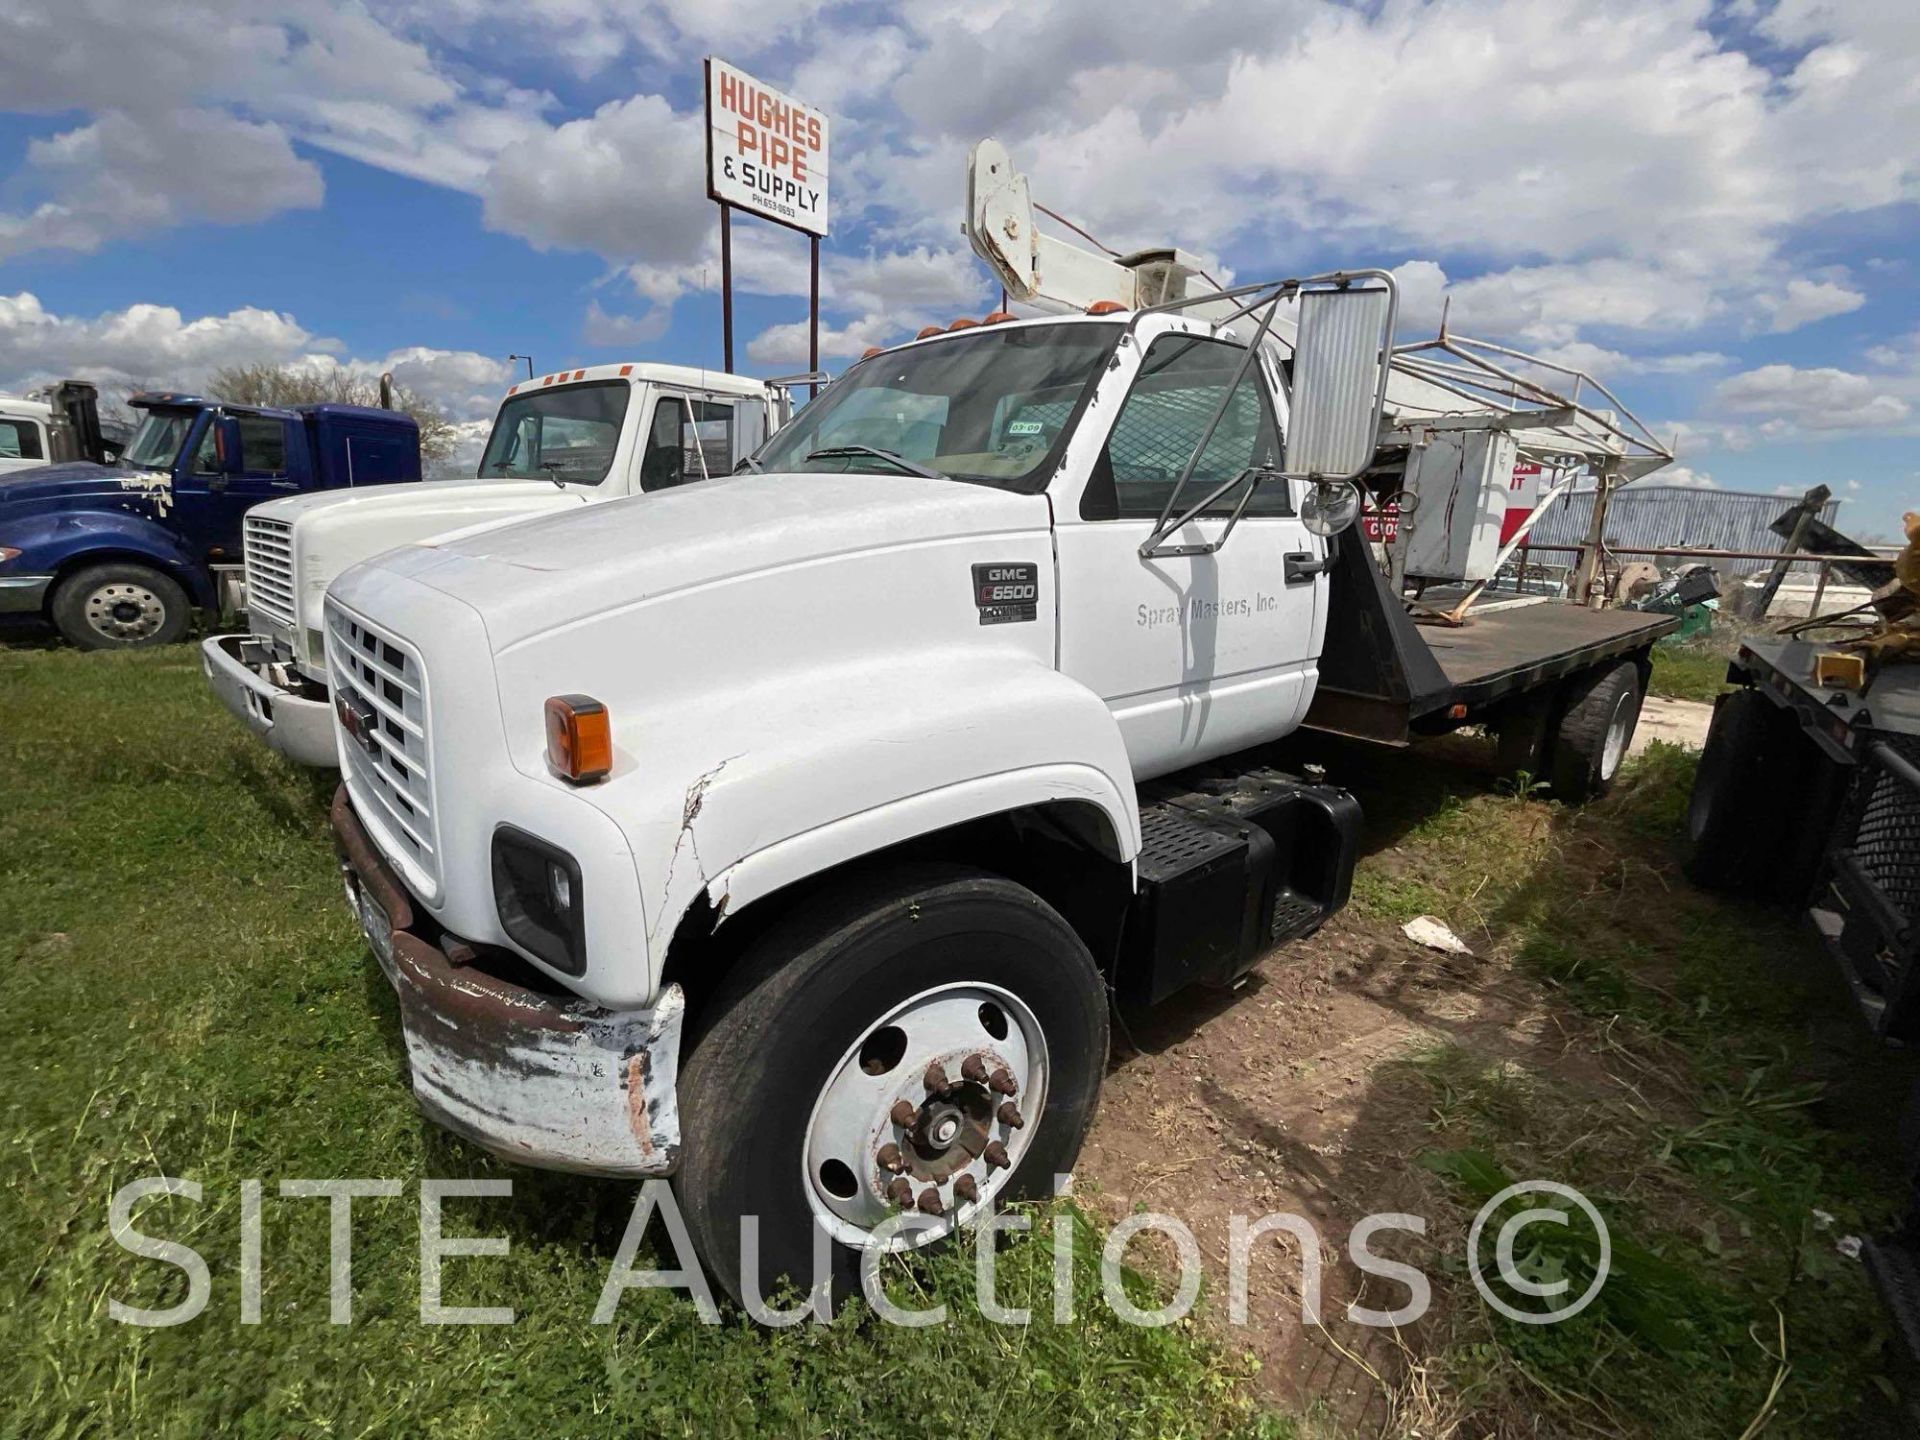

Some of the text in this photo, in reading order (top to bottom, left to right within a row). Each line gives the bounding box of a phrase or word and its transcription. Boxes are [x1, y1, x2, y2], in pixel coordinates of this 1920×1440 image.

[720, 71, 821, 153] HUGHES
[737, 120, 807, 183] PIPE
[724, 156, 820, 213] & SUPPLY
[988, 568, 1027, 581] GMC
[1137, 591, 1278, 629] Spray Masters, Inc.
